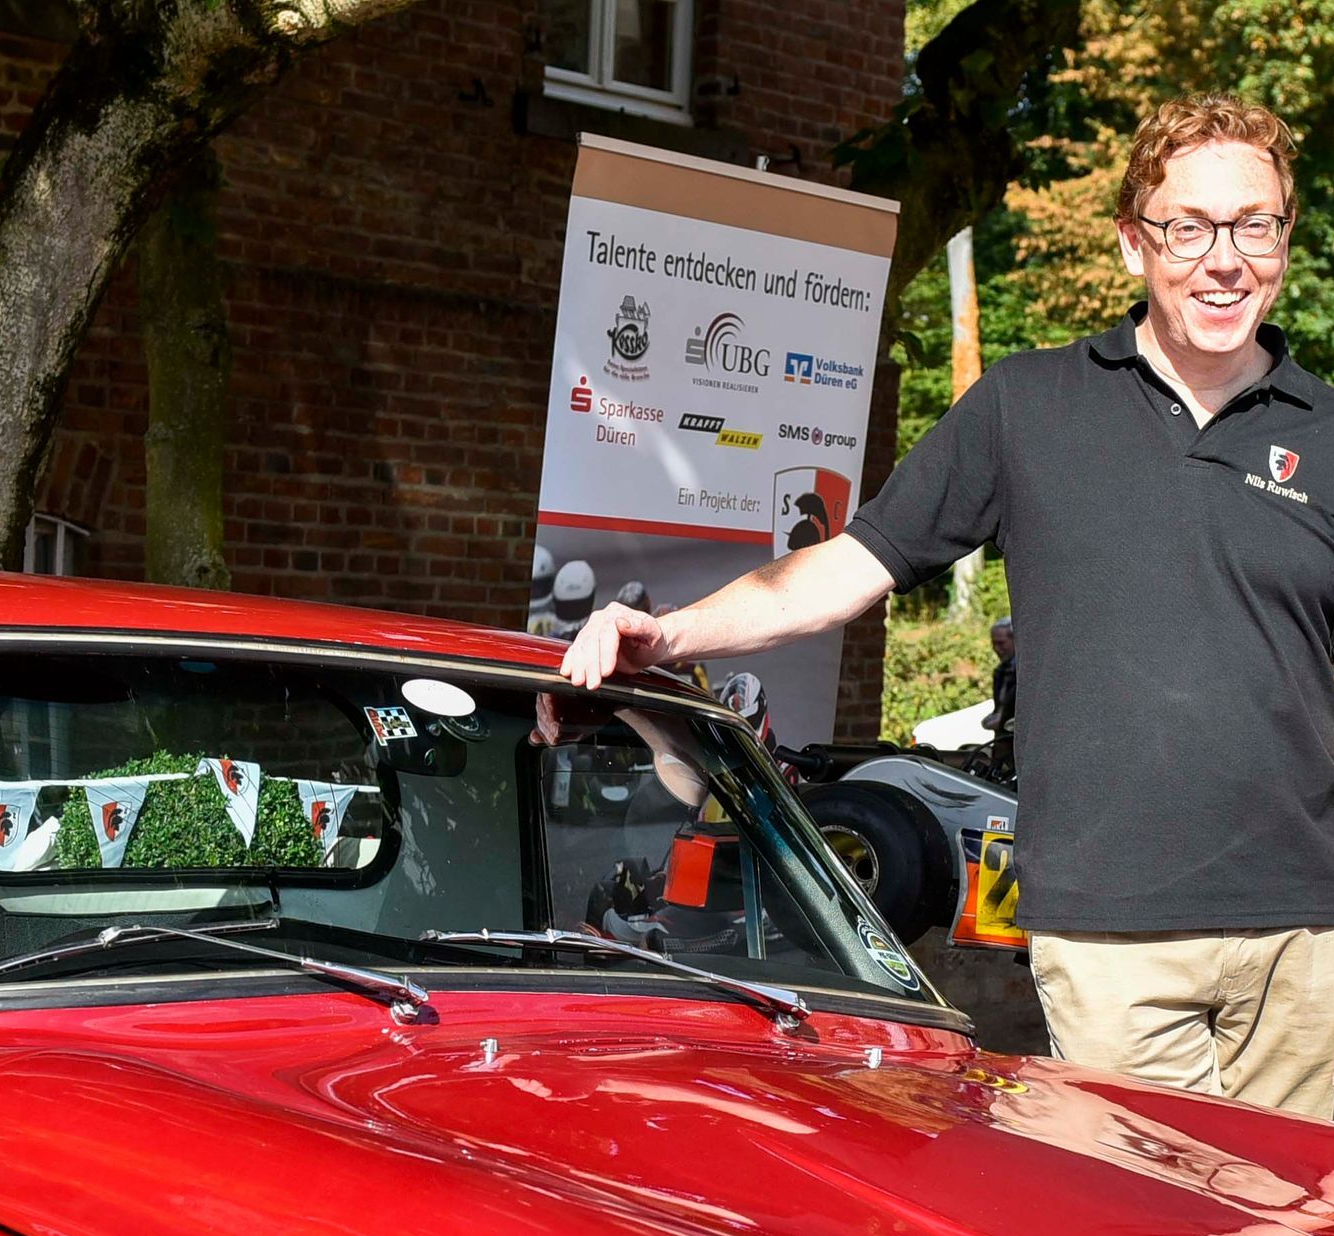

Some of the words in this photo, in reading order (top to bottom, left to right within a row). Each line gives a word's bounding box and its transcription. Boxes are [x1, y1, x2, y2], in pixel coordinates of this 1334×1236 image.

[587, 231, 656, 273] Talente
[664, 252, 756, 292] entdecken
[764, 269, 798, 299] und
[804, 271, 871, 312] fördern:
[721, 343, 770, 377] UBG
[815, 358, 865, 377] Volksbank
[814, 372, 843, 388] Düren
[845, 378, 858, 390] eG
[598, 398, 665, 423] Sparkasse
[596, 424, 636, 446] Düren
[681, 416, 723, 431] KRAFFT
[778, 423, 809, 441] SMS
[824, 432, 857, 448] group
[678, 487, 695, 506] Ein
[699, 489, 737, 513] Projekt
[740, 498, 761, 513] der:
[1266, 480, 1308, 504] Ruwisch
